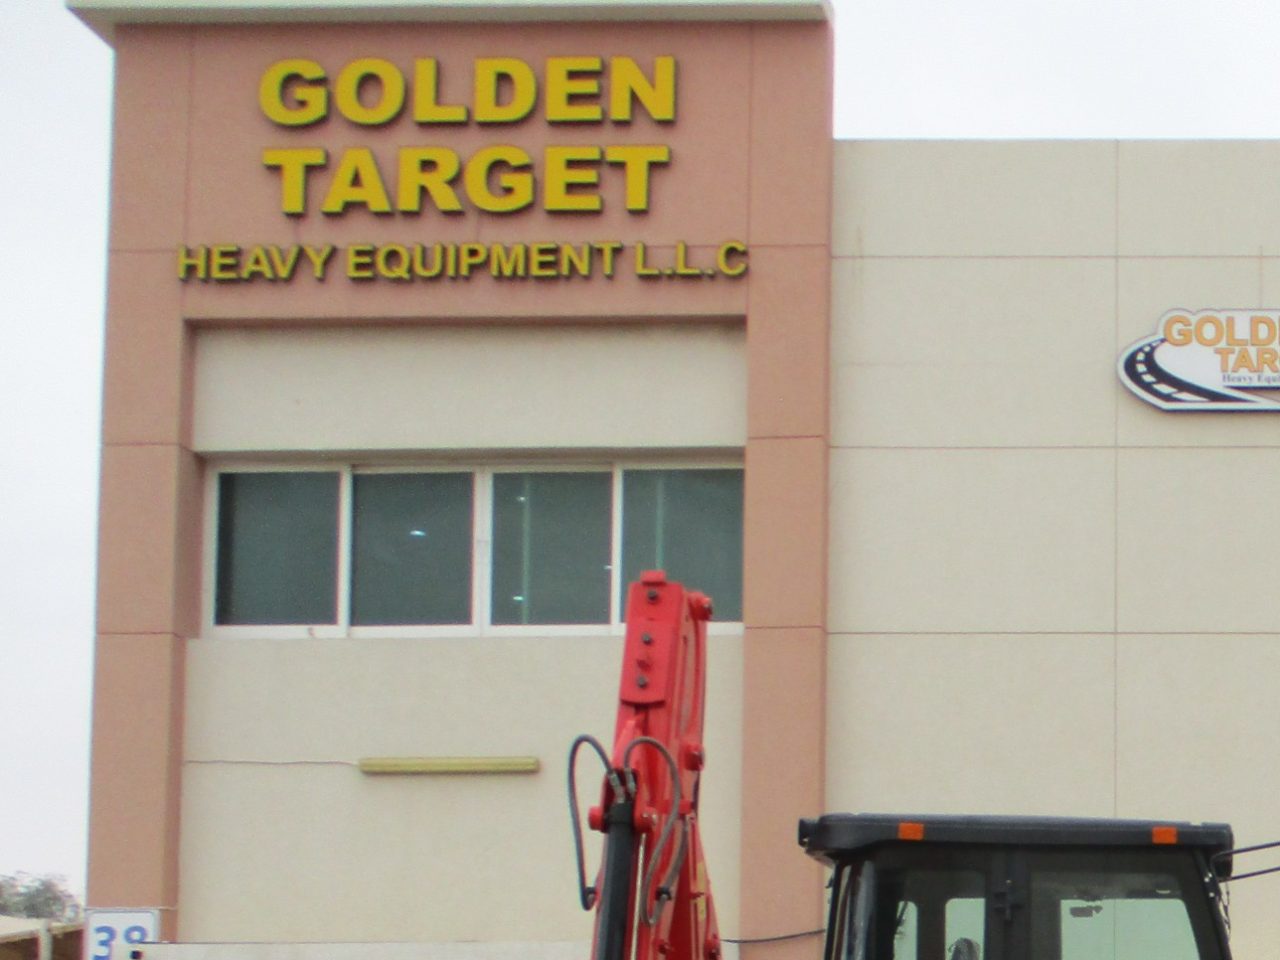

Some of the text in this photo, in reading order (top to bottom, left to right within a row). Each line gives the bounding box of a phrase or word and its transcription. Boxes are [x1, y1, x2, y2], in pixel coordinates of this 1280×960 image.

[259, 56, 677, 126] GOLDEN
[261, 144, 671, 213] TARGET
[177, 240, 748, 280] HEAVY EQUIPMENT L.L.C
[1222, 373, 1254, 385] Heavy
